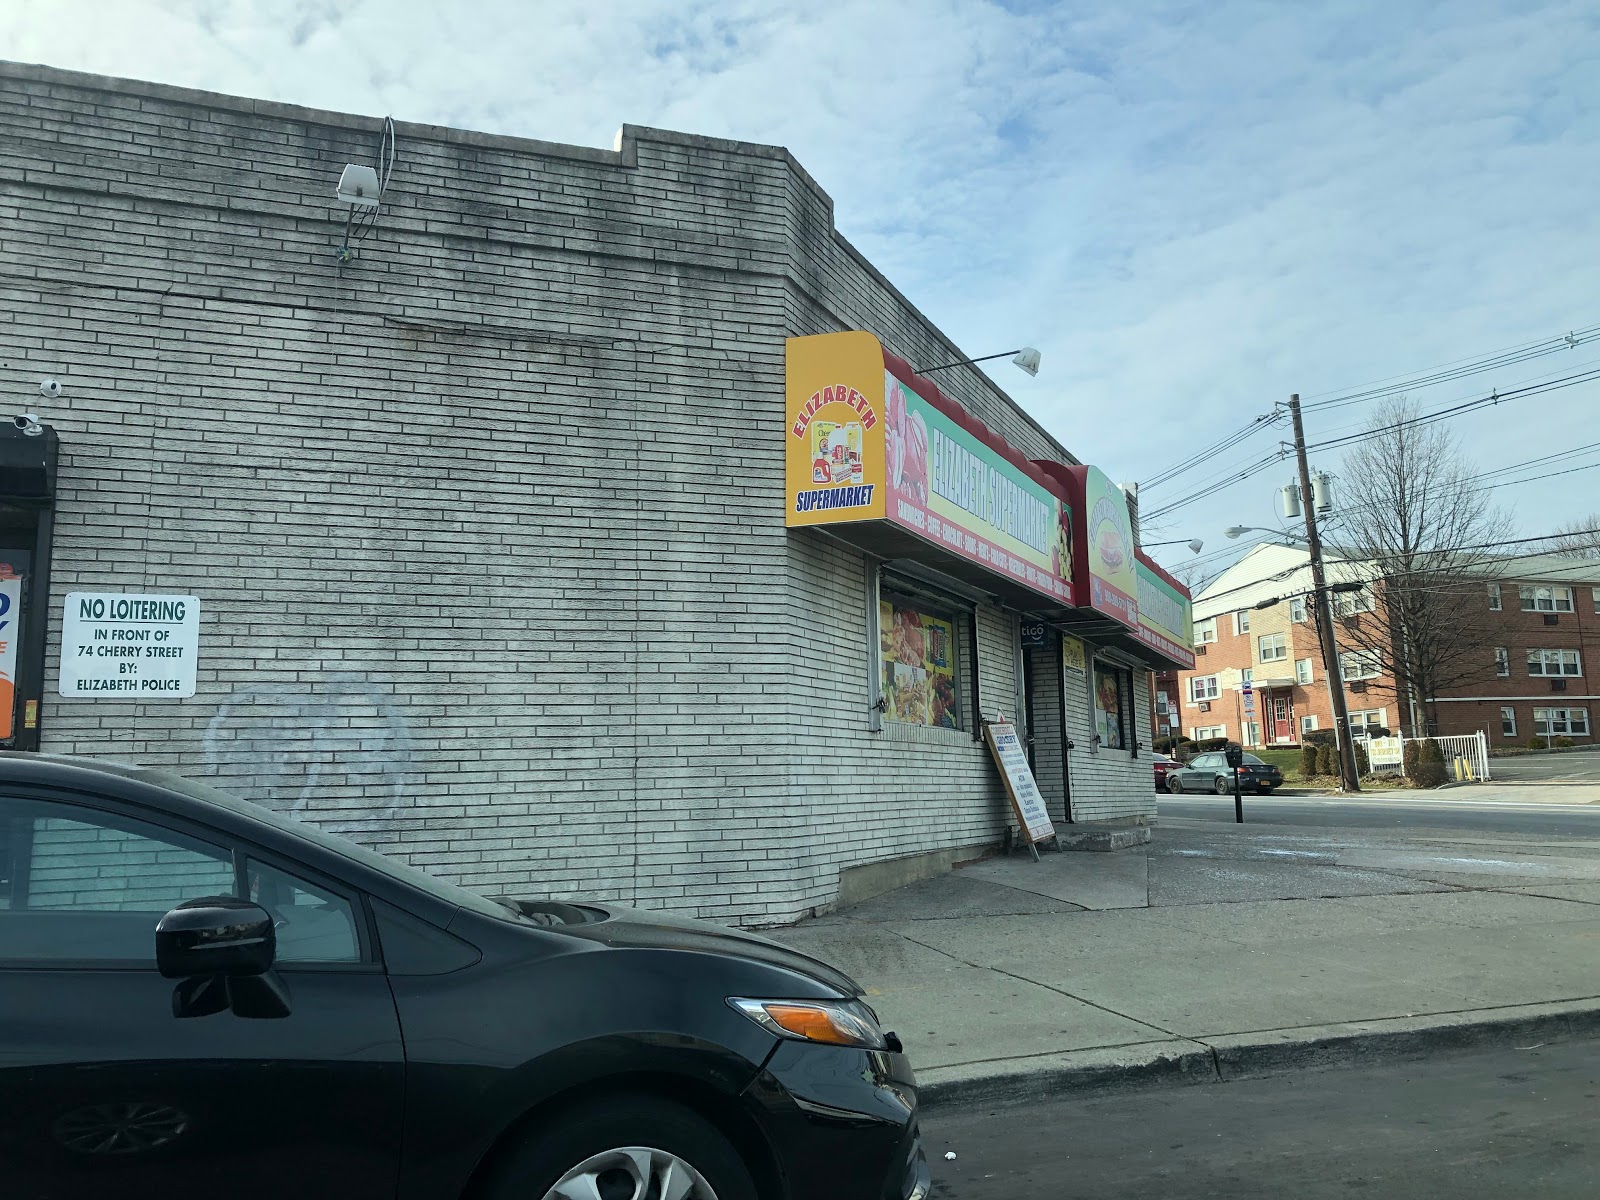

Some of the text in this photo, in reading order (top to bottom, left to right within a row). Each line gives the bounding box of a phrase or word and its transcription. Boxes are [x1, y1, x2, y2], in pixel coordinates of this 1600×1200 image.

[792, 384, 878, 440] ELIZABETH
[796, 484, 875, 513] SUPERMARKET
[931, 426, 988, 523] ELIZABETH
[988, 465, 1050, 556] SUPERMARKET
[79, 598, 186, 621] NO LOITERING
[94, 628, 170, 642] IN FRONT OF
[77, 645, 184, 658] 74 CHERRY STREET
[119, 662, 138, 674] BY:
[77, 679, 180, 691] ELIZABETH POLICE
